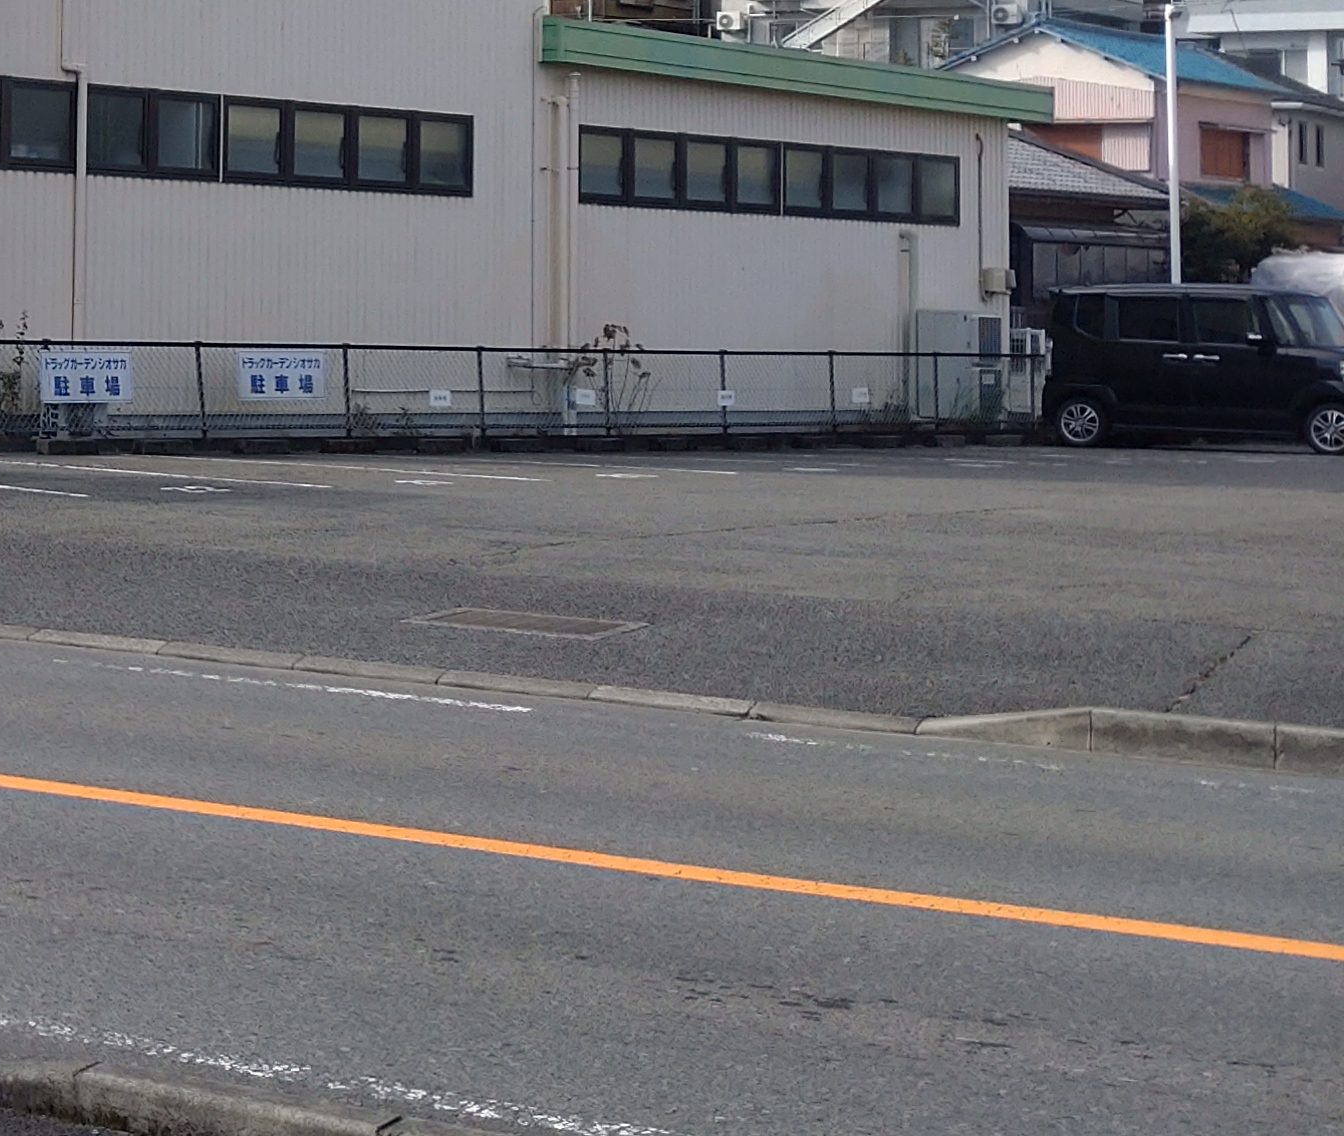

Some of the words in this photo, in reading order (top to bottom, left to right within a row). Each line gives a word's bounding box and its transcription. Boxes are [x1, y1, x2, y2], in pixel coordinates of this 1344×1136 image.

[54, 375, 121, 397] 駐車場
[250, 374, 314, 394] 駐車場
